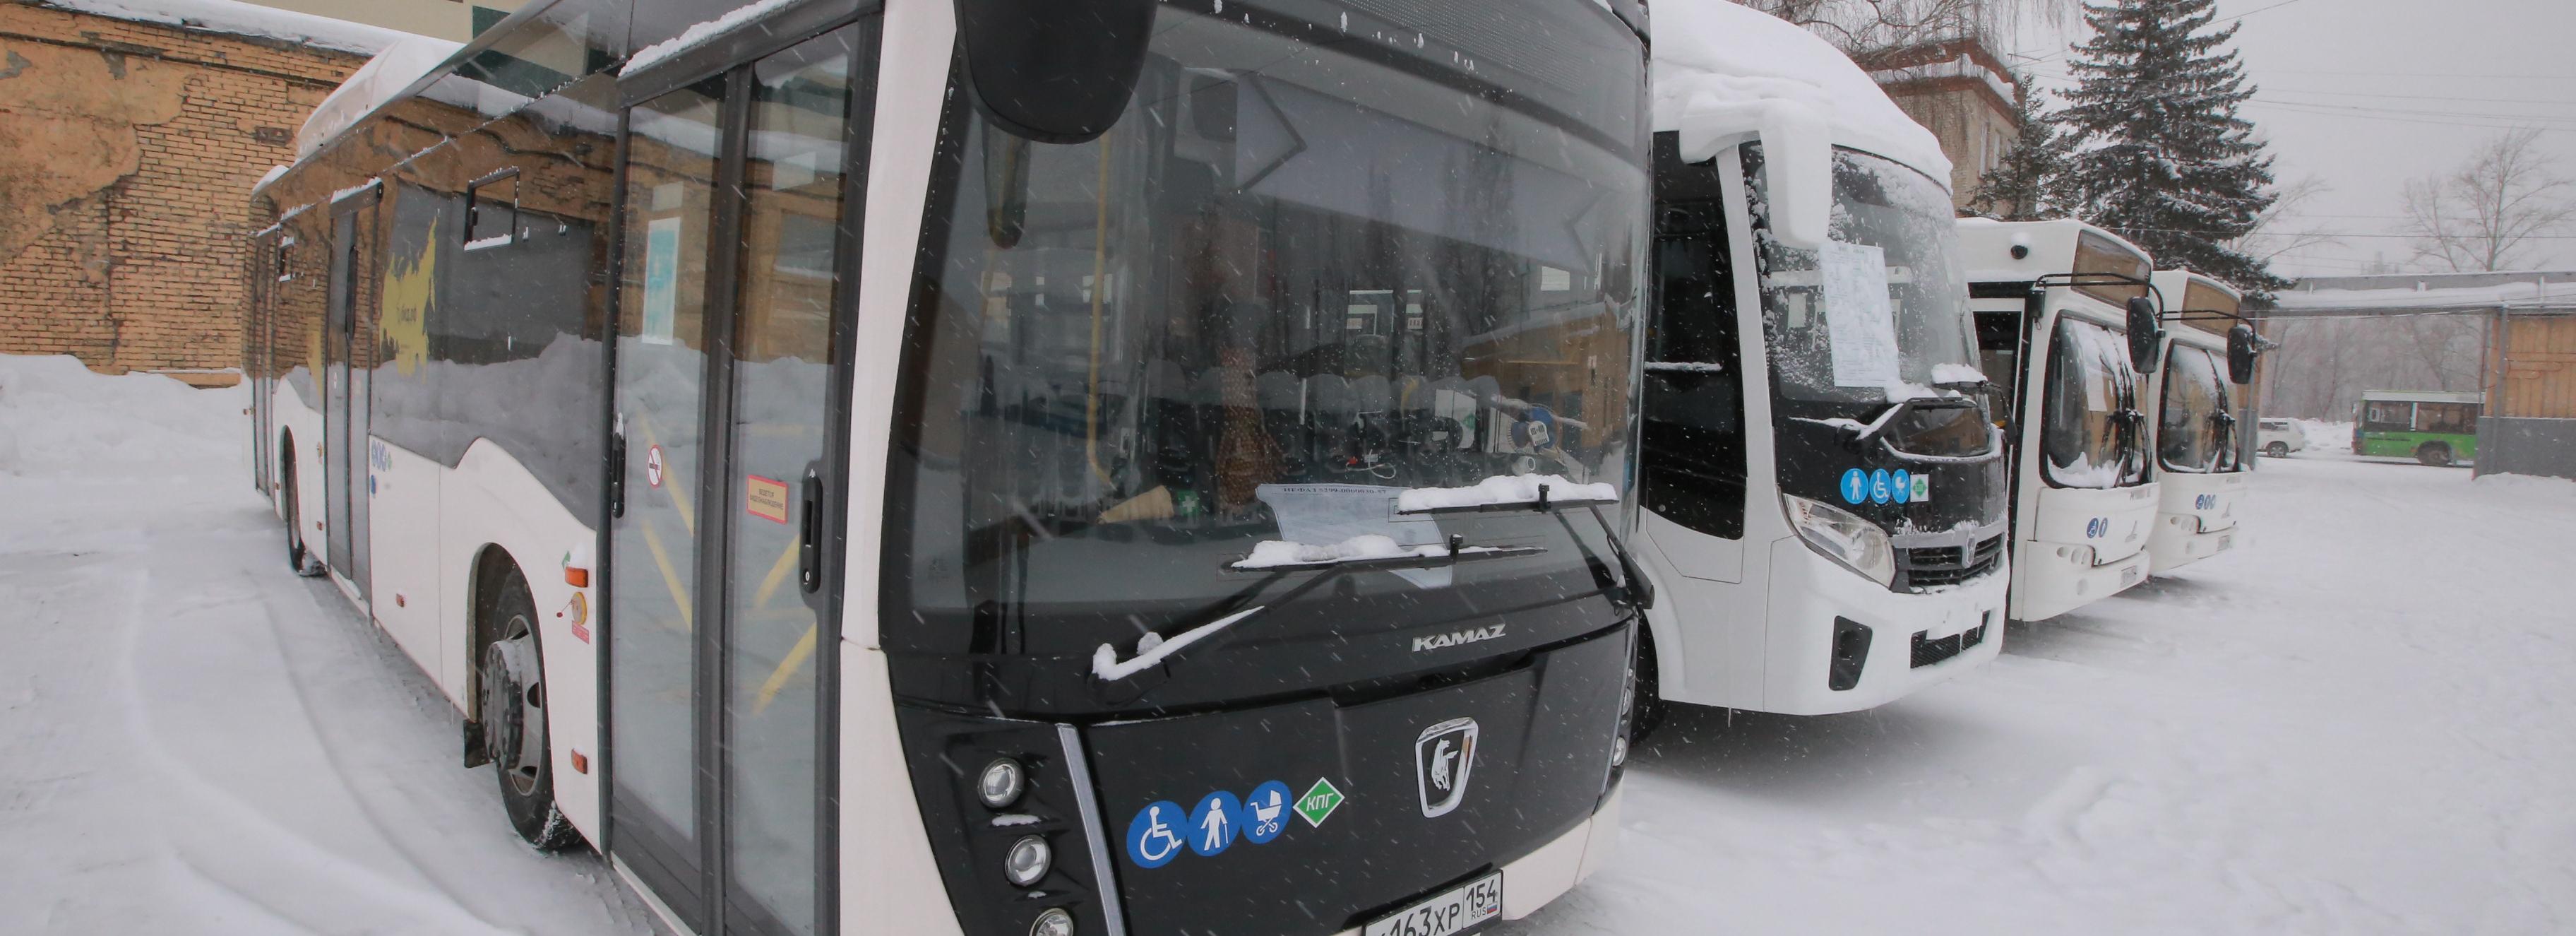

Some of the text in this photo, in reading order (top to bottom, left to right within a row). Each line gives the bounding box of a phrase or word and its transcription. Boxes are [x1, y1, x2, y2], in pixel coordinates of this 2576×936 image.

[1412, 624, 1506, 652] KAMAZ
[1306, 793, 1334, 812] КПГ
[1382, 879, 1496, 936] 163ХР 154
[1471, 906, 1486, 919] RUS
